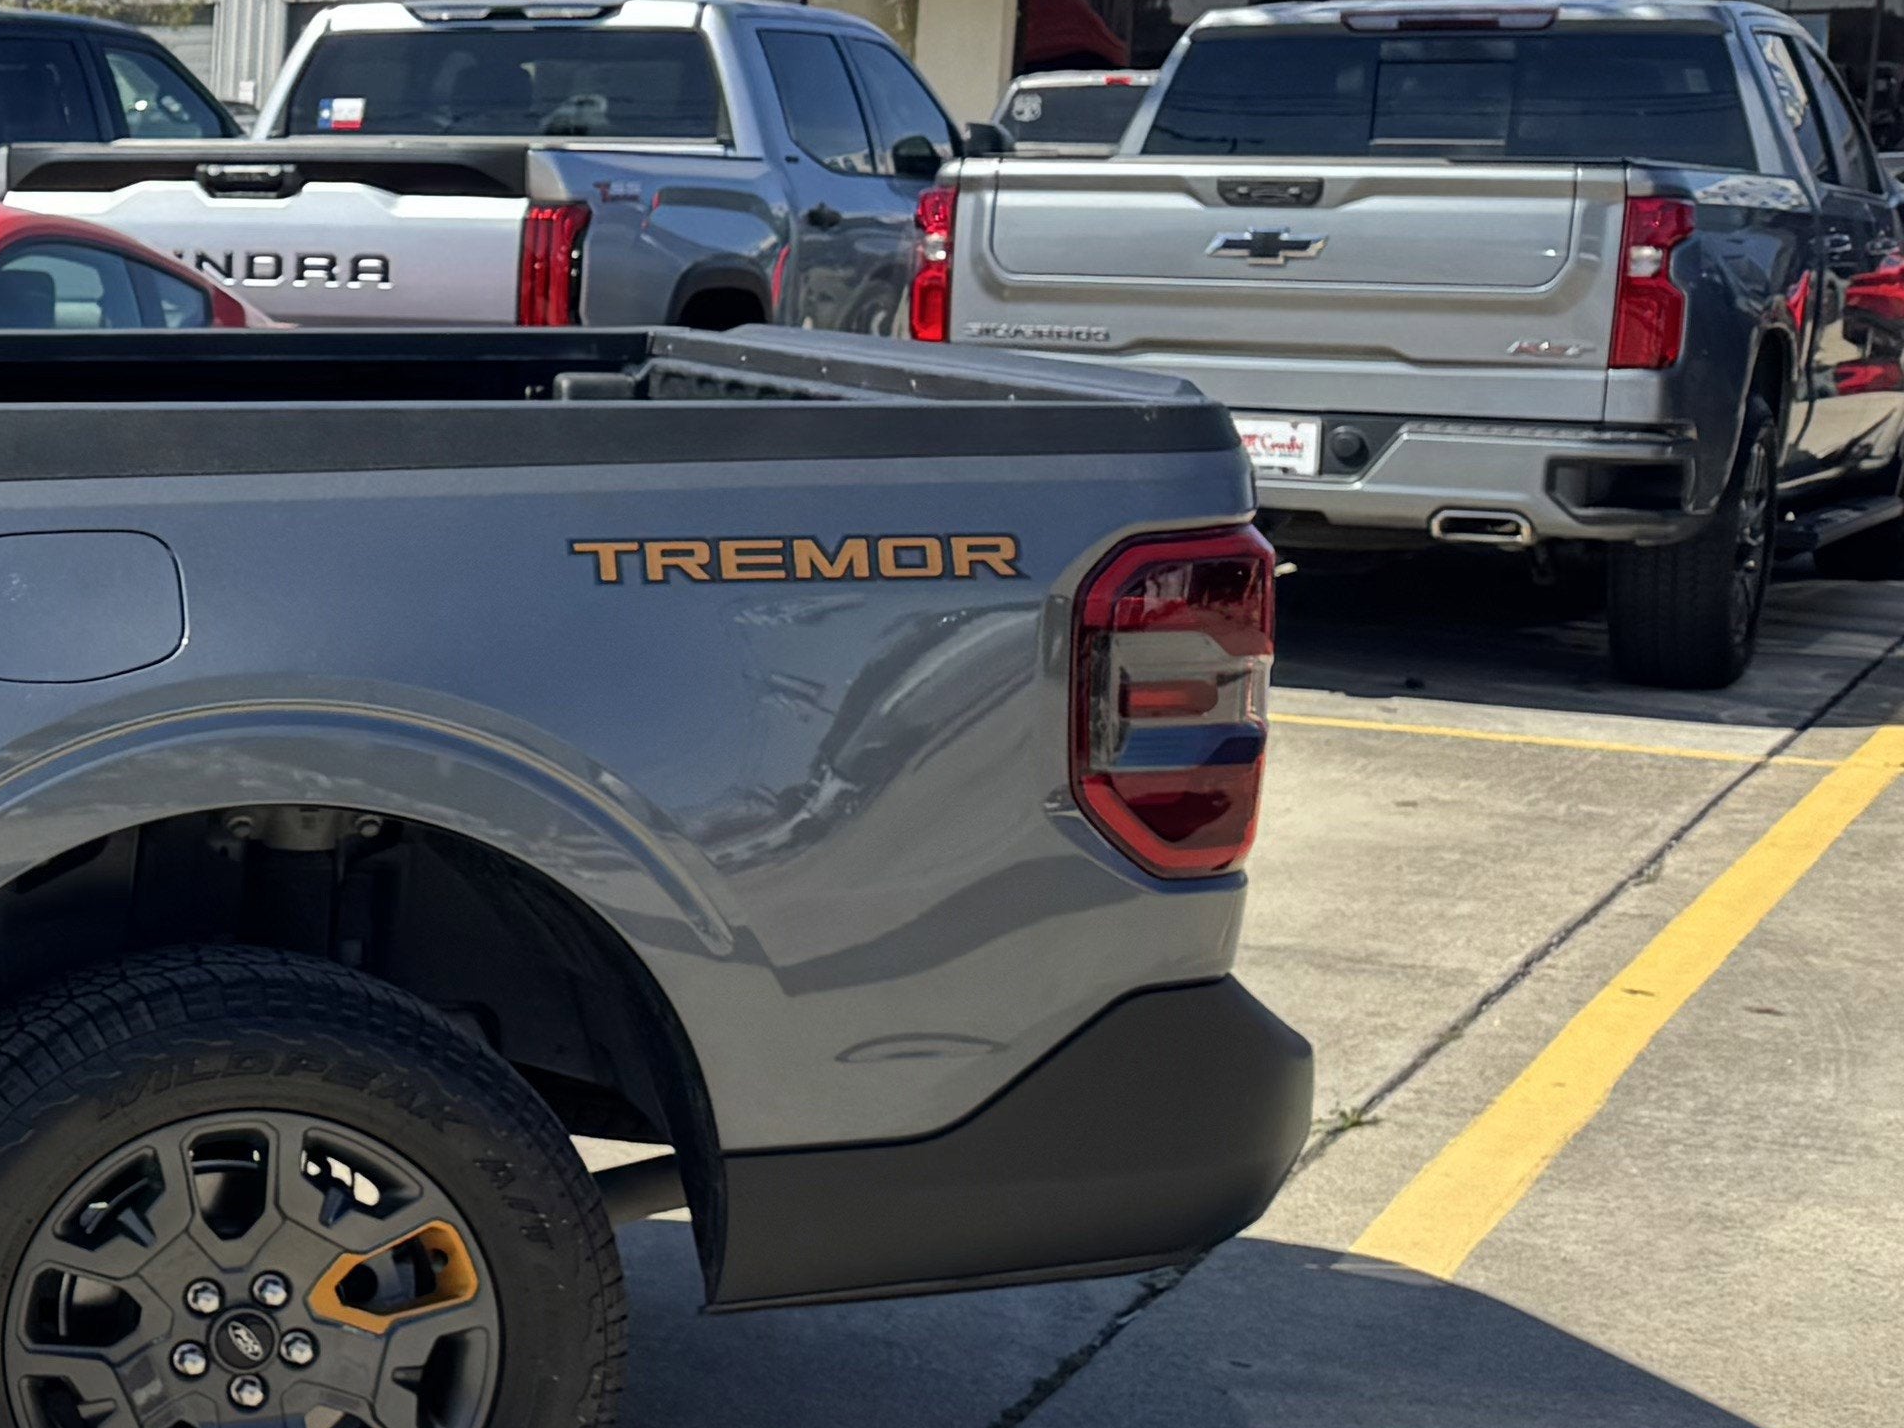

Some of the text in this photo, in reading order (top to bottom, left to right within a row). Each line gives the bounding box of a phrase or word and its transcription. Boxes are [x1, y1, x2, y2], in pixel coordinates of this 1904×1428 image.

[173, 249, 394, 290] NDRA
[568, 534, 1030, 584] TREMOR
[98, 1050, 468, 1133] WILDPEAK
